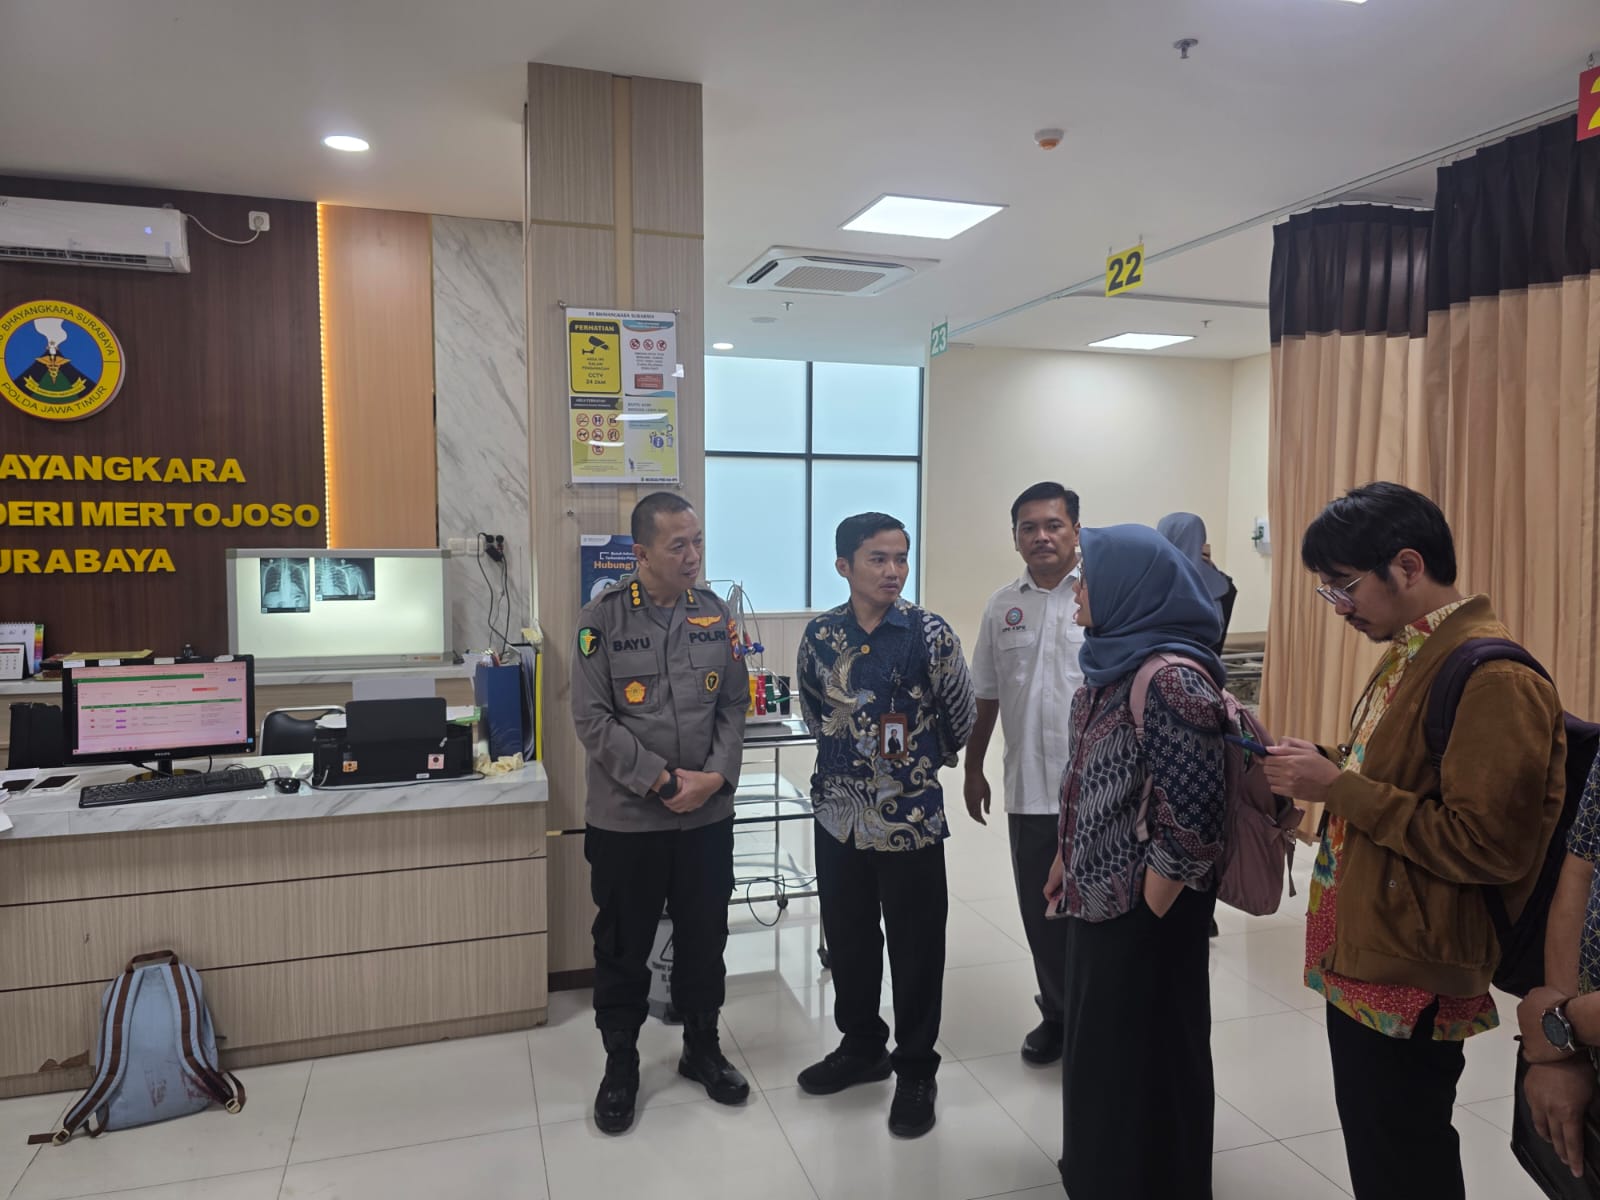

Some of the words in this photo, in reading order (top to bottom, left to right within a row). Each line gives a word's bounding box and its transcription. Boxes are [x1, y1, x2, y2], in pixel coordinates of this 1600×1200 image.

[1108, 251, 1141, 292] 22
[2, 305, 74, 332] BHAYANGKARA
[75, 312, 115, 356] SURABAYA
[574, 324, 614, 332] PERHATIAN
[931, 327, 946, 354] 23
[1, 382, 38, 412] POLDA
[41, 405, 74, 414] JAWA
[76, 385, 107, 410] TIMUR
[82, 502, 320, 528] MERTOJOSO
[594, 560, 634, 570] Hubungi
[612, 637, 651, 652] BAYU
[689, 630, 727, 643] POLRI
